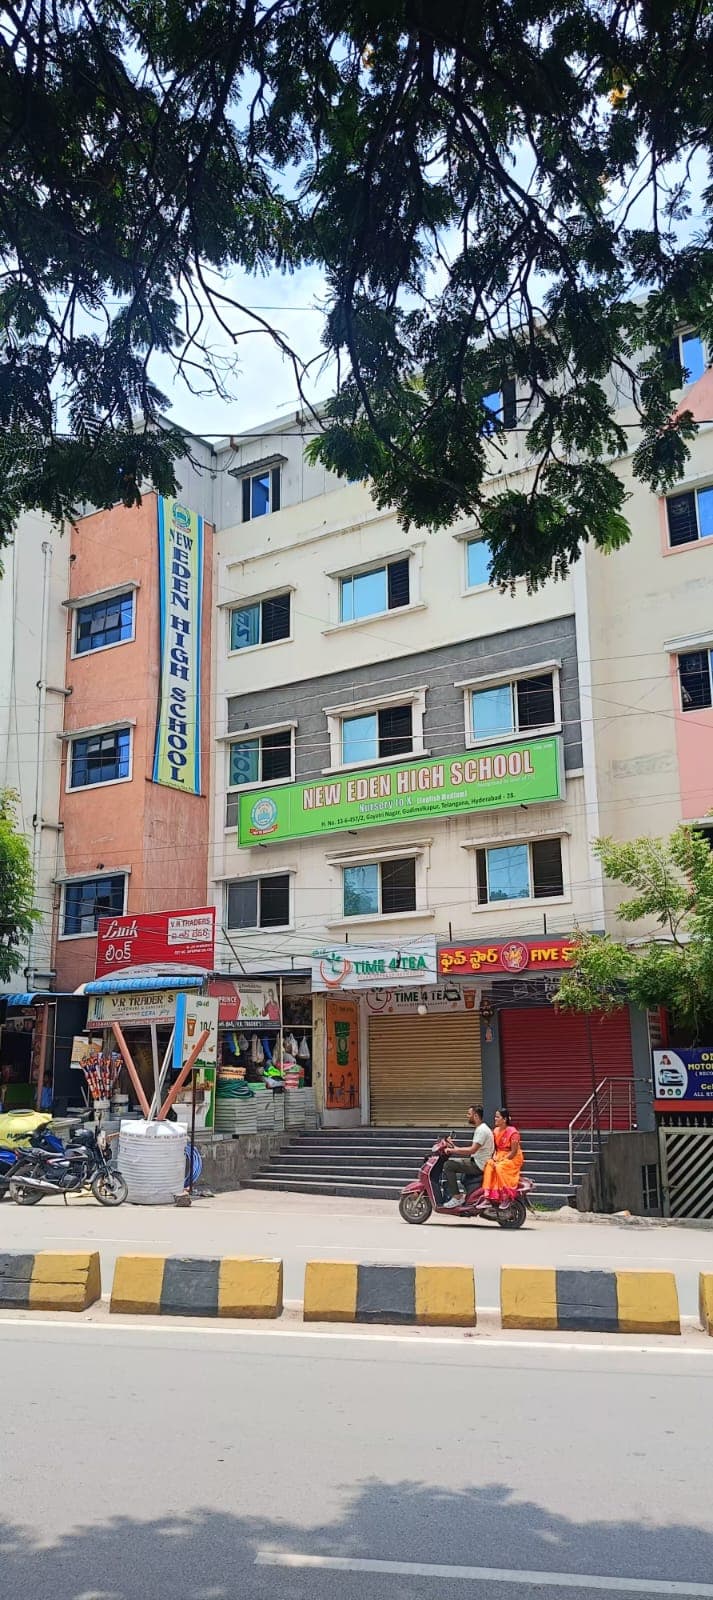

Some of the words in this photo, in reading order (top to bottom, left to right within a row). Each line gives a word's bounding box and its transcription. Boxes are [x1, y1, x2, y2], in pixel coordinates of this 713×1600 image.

[169, 528, 193, 551] NEW
[170, 547, 191, 611] EDEN
[170, 614, 190, 682] HIGH
[167, 686, 188, 784] SCHOOL
[303, 782, 342, 811] NEW
[346, 773, 391, 802] EDEN
[396, 763, 444, 794] HIGH
[450, 748, 534, 786] SCHOOL
[359, 800, 393, 813] Nursery
[471, 793, 502, 806] Hyderabad
[353, 957, 385, 975] TIME
[389, 958, 398, 972] 4
[401, 954, 427, 971] TEA
[531, 947, 559, 962] FIVE
[394, 991, 419, 1003] TIME
